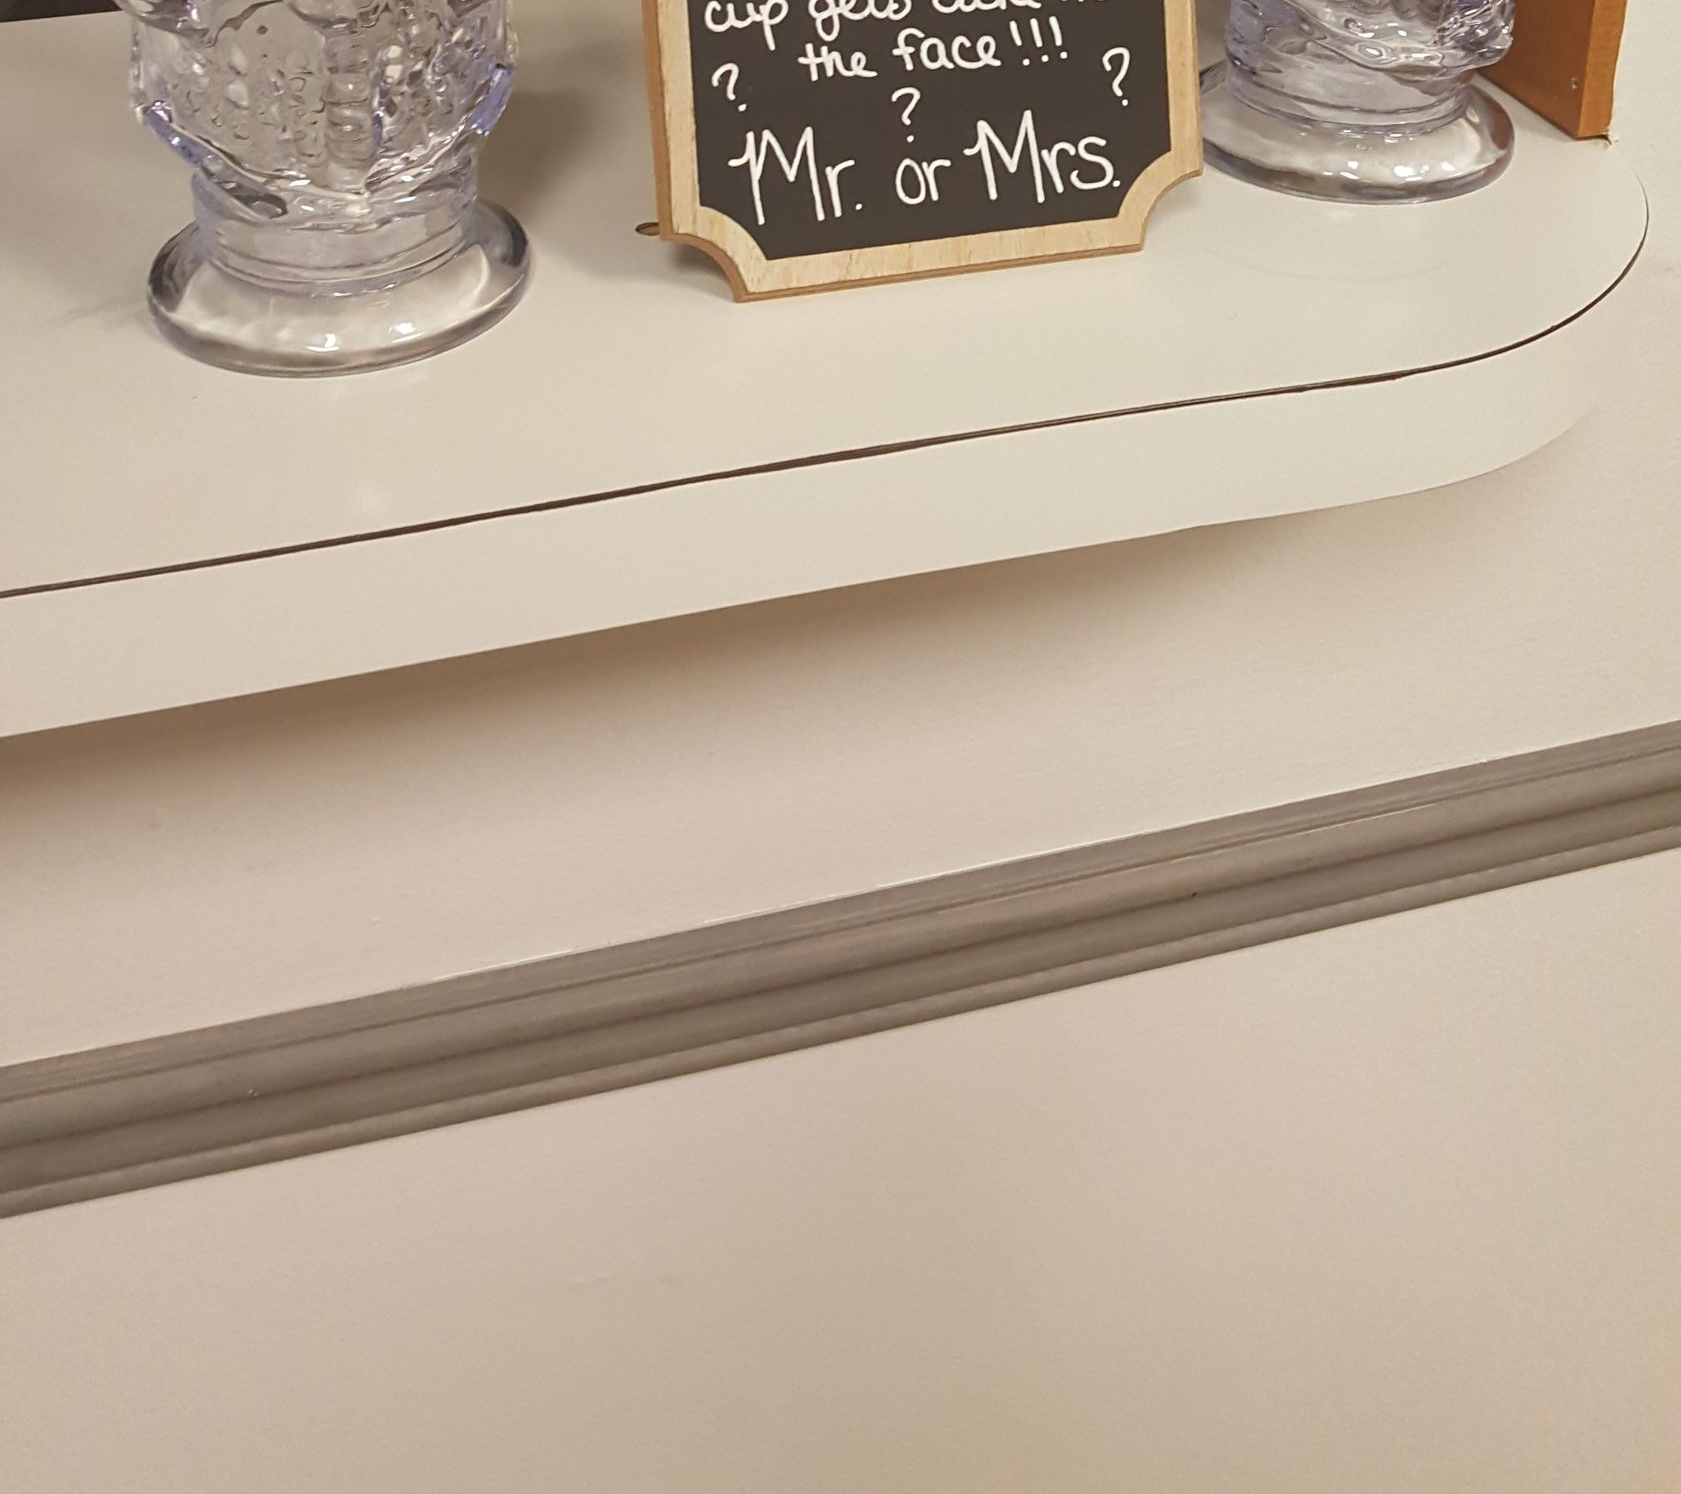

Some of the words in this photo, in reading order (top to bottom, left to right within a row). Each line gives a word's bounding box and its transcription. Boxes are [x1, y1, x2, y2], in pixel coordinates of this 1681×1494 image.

[798, 42, 878, 82] the
[728, 126, 864, 226] Mr.
[895, 157, 952, 205] or
[963, 109, 1121, 204] Mrs.
